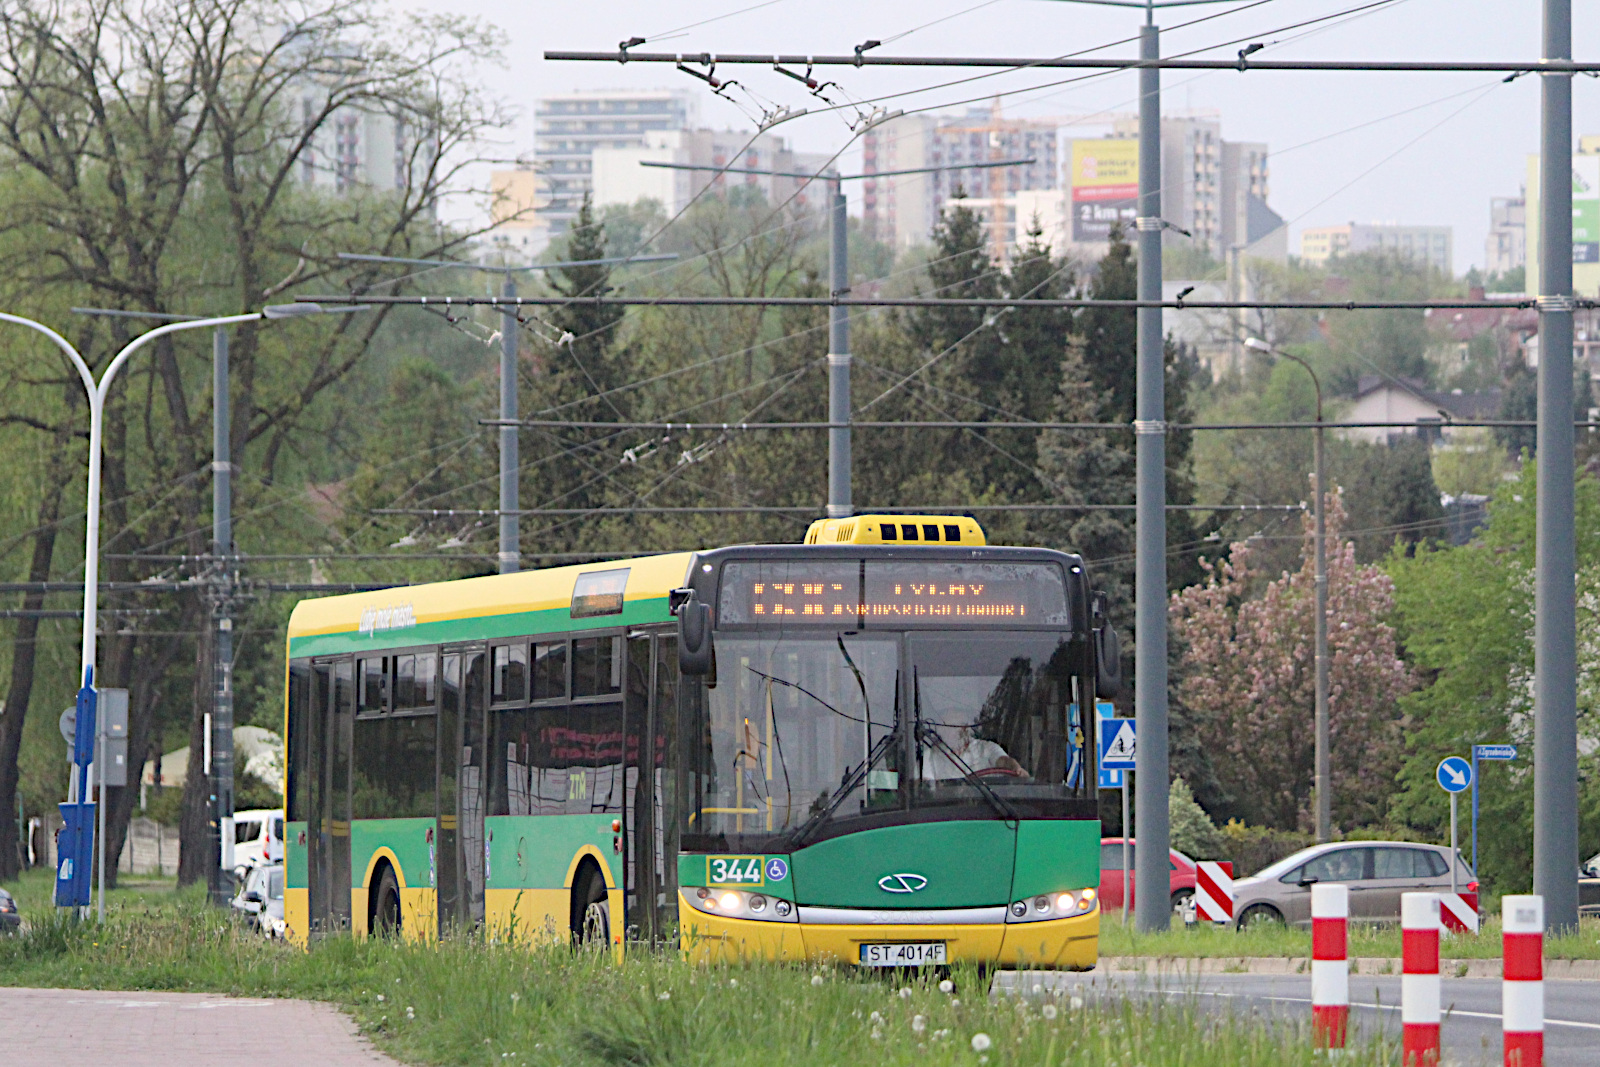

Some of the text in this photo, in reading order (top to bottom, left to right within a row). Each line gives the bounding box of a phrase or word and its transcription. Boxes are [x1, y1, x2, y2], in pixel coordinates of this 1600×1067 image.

[1081, 204, 1119, 221] 2 km
[569, 771, 587, 800] ZTM
[712, 858, 760, 882] 344
[870, 945, 943, 961] ST 4014F
